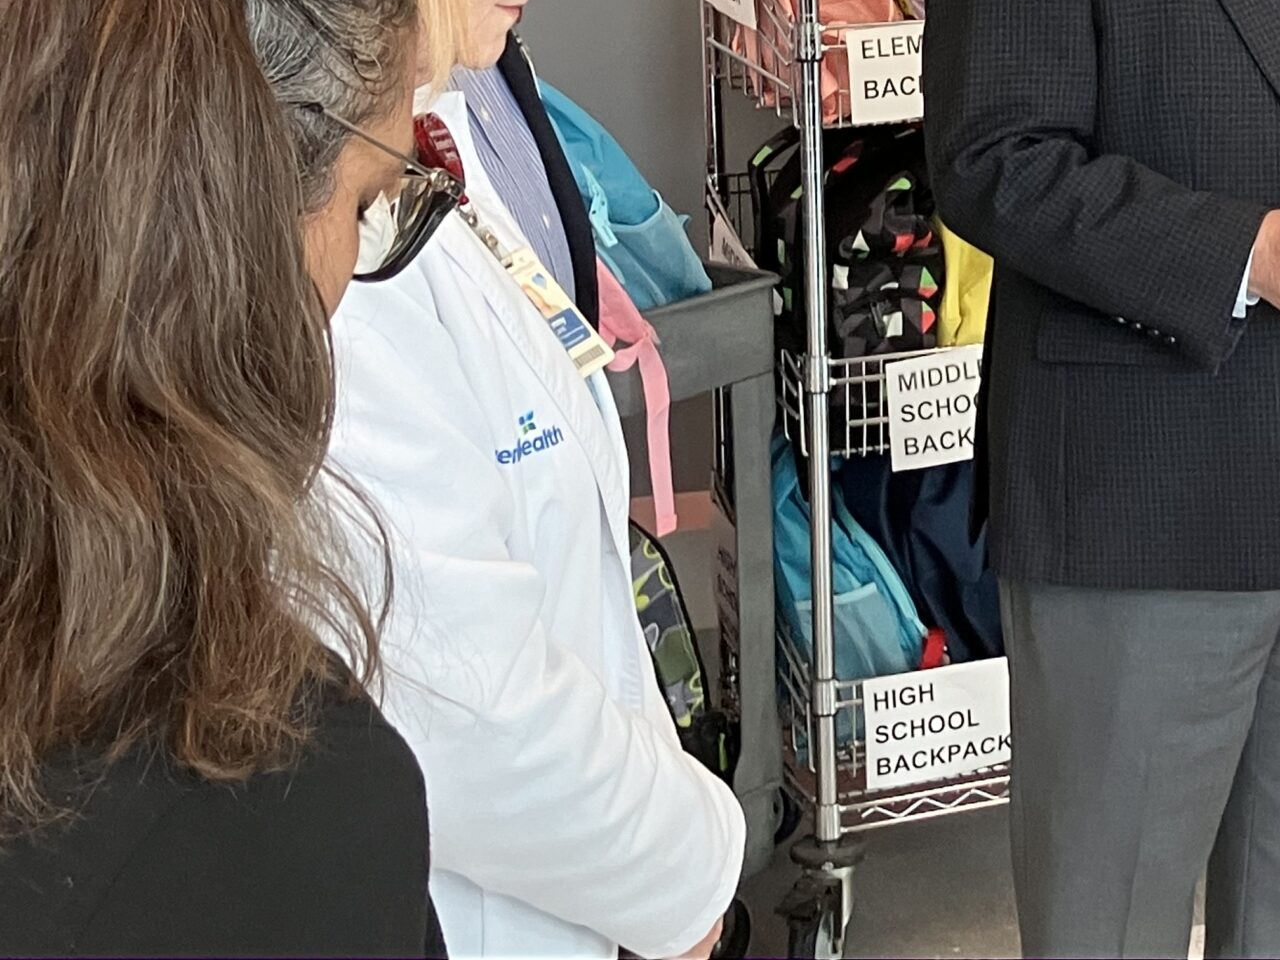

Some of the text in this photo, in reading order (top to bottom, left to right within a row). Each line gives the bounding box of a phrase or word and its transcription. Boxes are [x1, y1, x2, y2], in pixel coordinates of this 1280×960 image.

[864, 76, 923, 100] BAC
[872, 682, 936, 713] HIGH
[874, 707, 980, 745] SCHOOL
[875, 733, 1011, 777] BACKPACK
